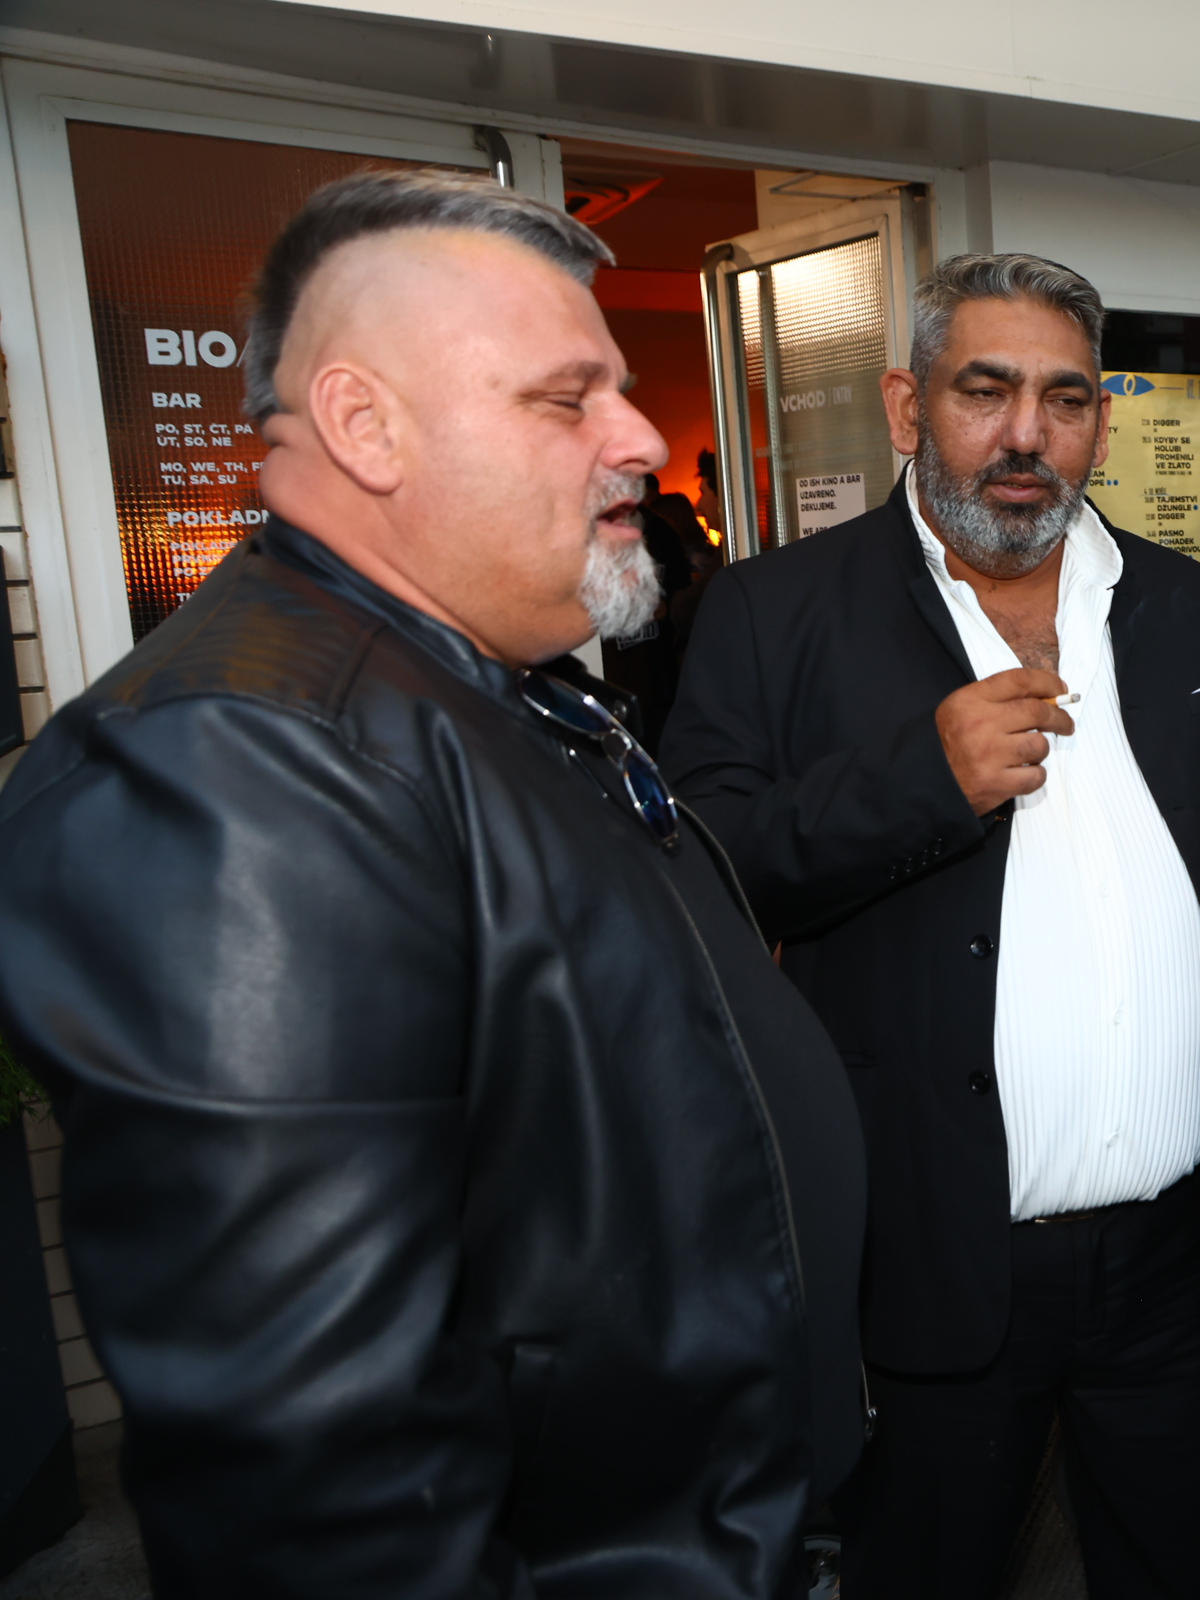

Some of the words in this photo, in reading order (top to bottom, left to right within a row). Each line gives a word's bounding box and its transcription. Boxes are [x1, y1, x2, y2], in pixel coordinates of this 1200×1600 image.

[152, 392, 202, 408] BAR
[780, 390, 826, 412] VCHOD
[155, 424, 180, 435] PO,
[184, 424, 205, 435] ST,
[184, 437, 207, 447] SO,
[212, 437, 232, 446] NE
[160, 462, 186, 472] MO,
[190, 462, 220, 472] WE,
[223, 462, 248, 472] TH,
[161, 475, 186, 486] TU,
[190, 475, 214, 485] SA,
[218, 475, 236, 484] SU
[822, 477, 838, 485] KINO
[846, 475, 860, 483] BAR
[167, 510, 270, 525] POKLADN
